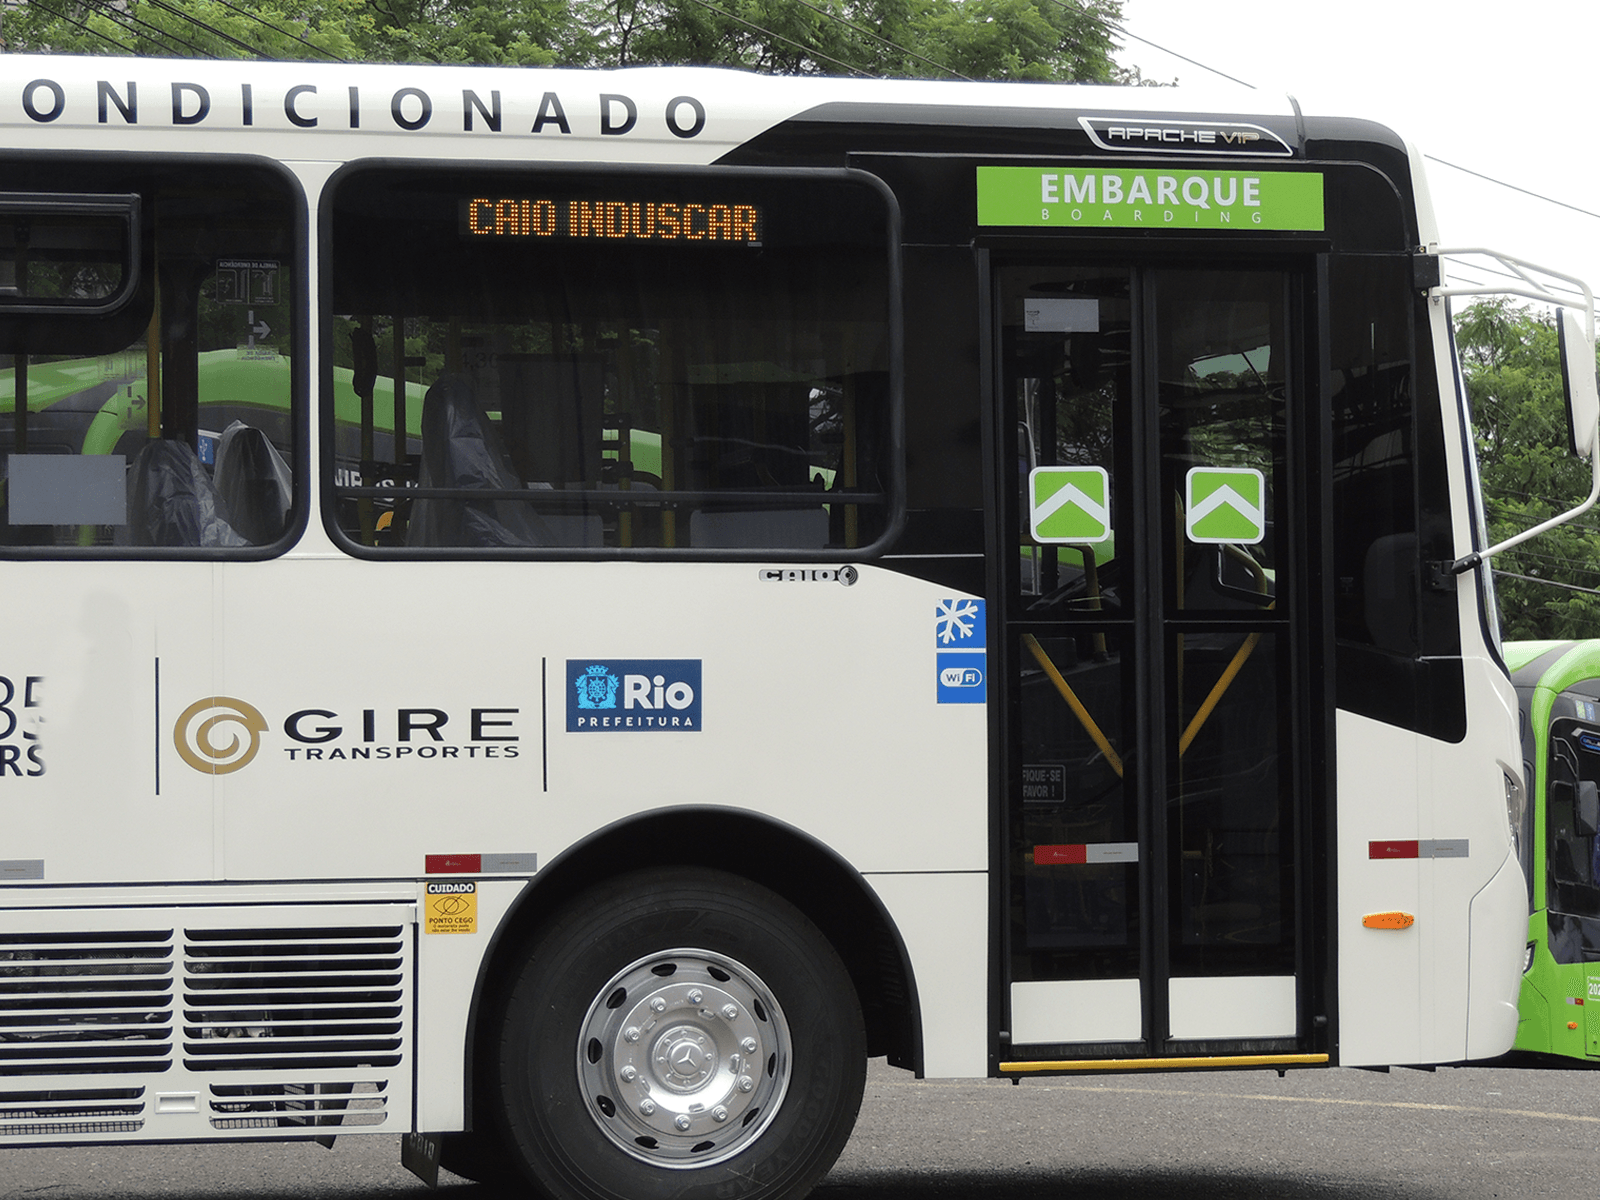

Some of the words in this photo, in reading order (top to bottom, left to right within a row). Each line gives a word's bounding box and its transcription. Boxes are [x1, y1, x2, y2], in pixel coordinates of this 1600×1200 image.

[22, 78, 706, 139] ONDICIONADO
[1108, 127, 1216, 143] APACHE
[1220, 131, 1260, 144] VIP
[1041, 173, 1261, 210] EMBARQUE
[469, 199, 556, 236] CAIO
[569, 200, 757, 241] INDUSCAR
[1041, 208, 1262, 225] BOARDING
[624, 674, 694, 710] Rio
[283, 708, 520, 744] GIRE
[578, 716, 693, 727] PREFEITURA
[284, 746, 520, 760] TRANSPORTES
[428, 883, 474, 893] CUIDADO
